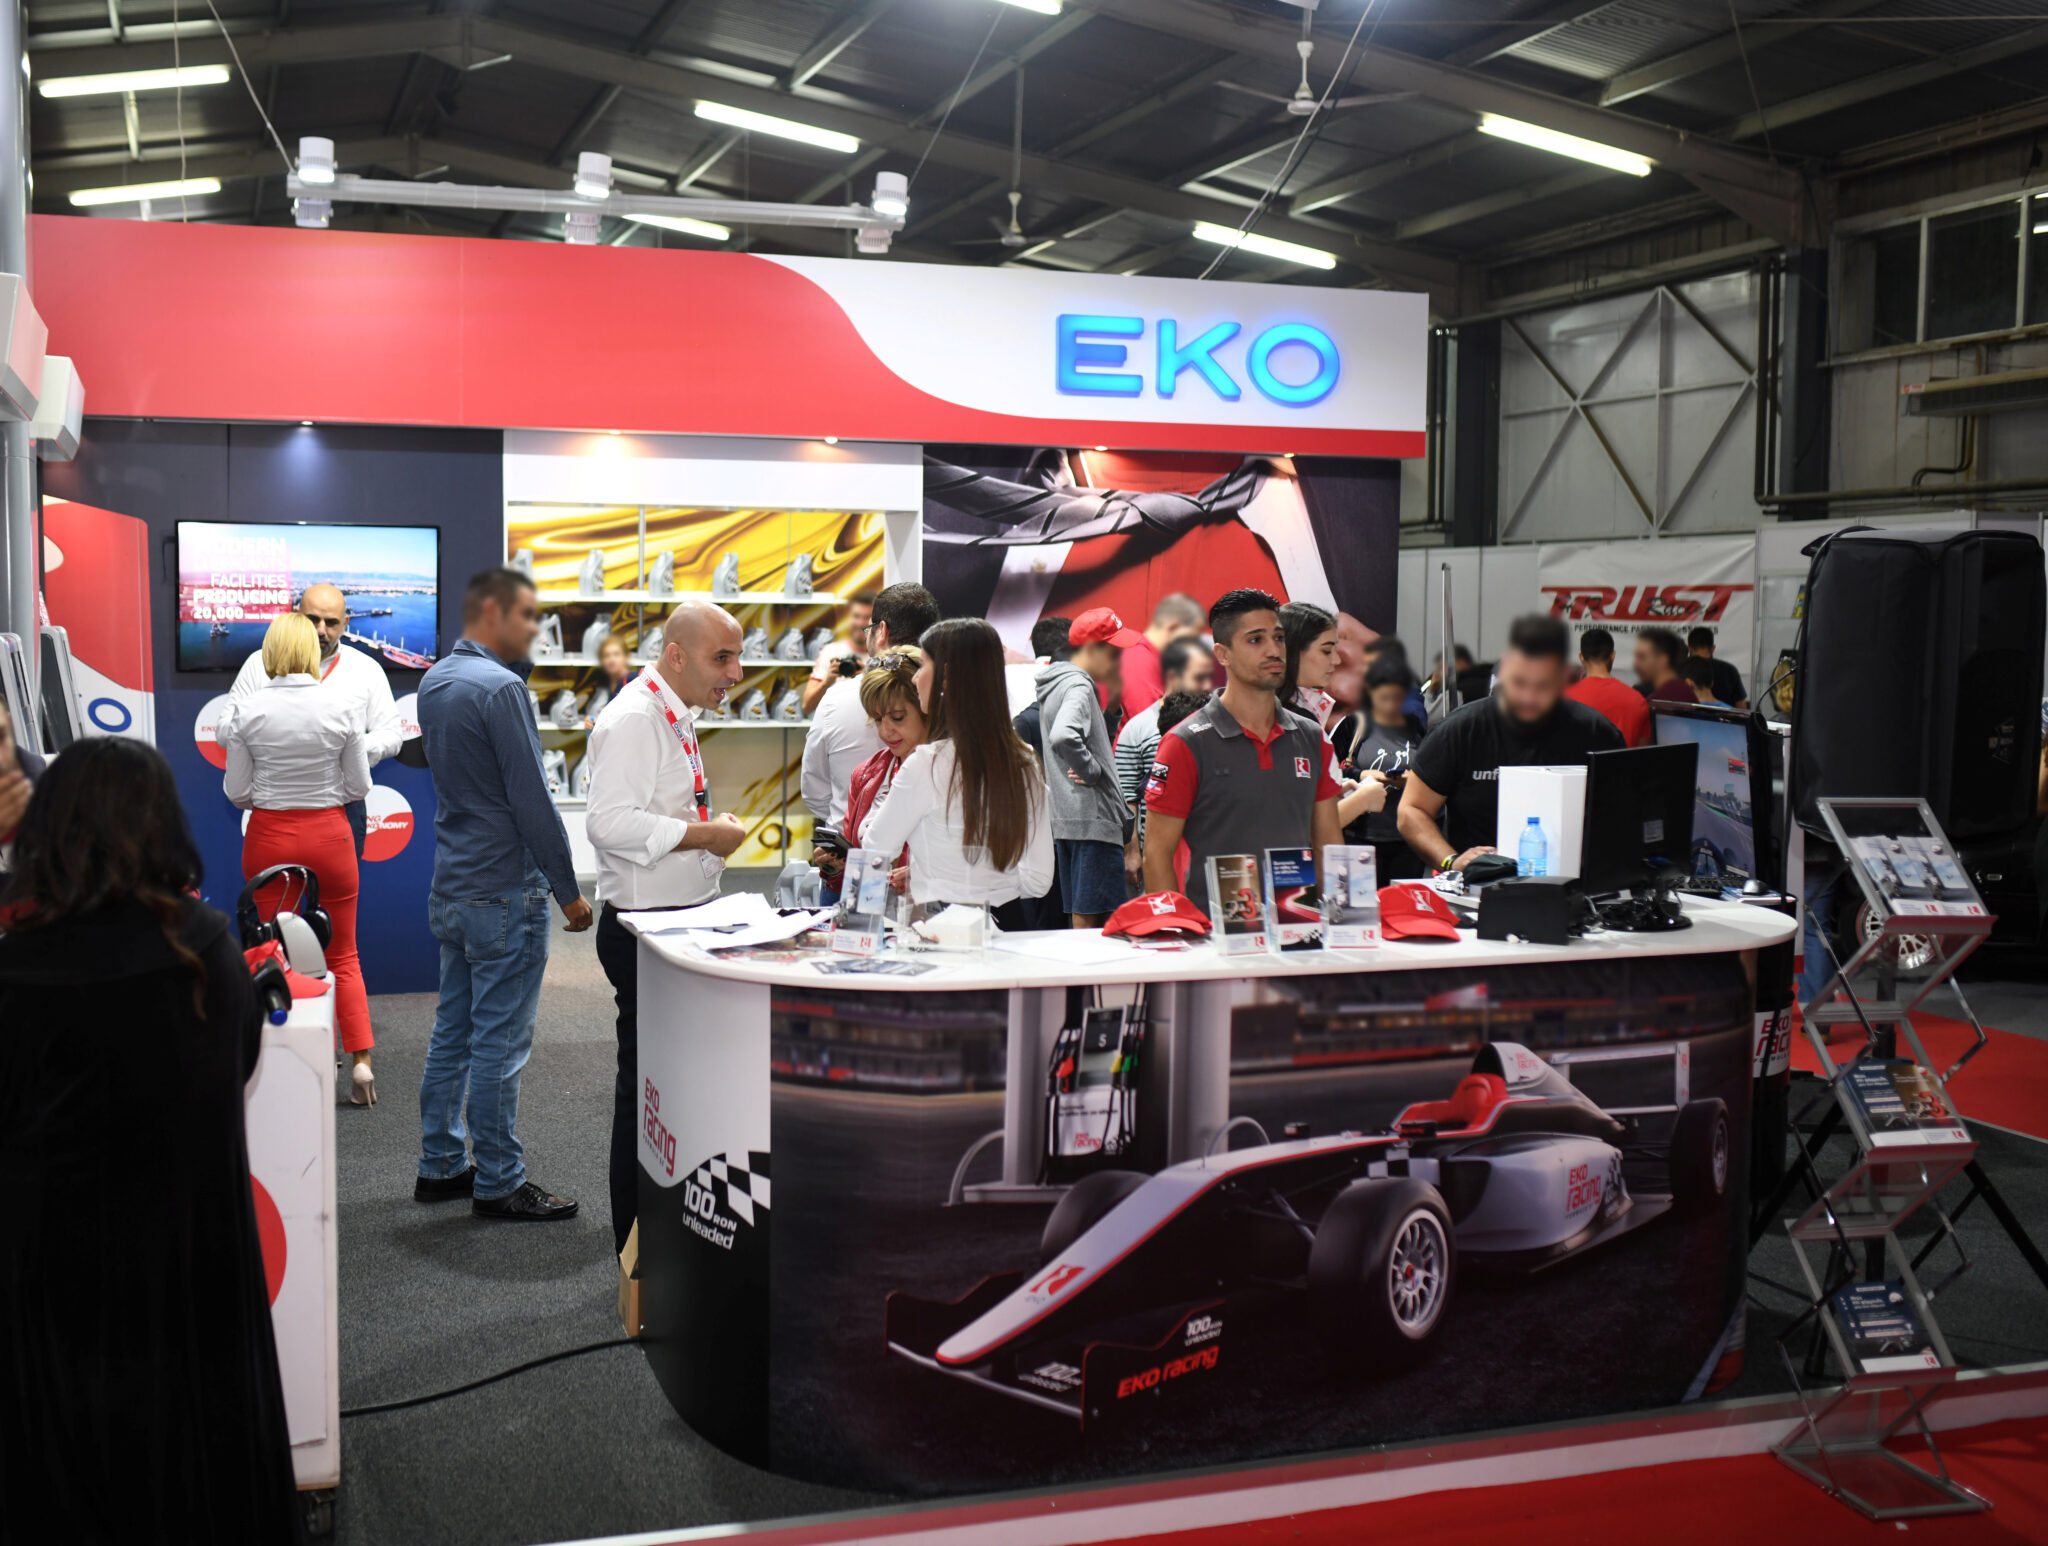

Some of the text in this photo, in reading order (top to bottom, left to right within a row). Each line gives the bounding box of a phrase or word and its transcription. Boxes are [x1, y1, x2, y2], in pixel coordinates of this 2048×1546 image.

[1056, 313, 1340, 408] EKO
[193, 589, 289, 604] PRODUCING
[210, 573, 288, 588] FACILITIES
[193, 606, 244, 621] 20,000
[1541, 584, 1754, 622] TRUST
[645, 1077, 660, 1113] EKO
[643, 1103, 677, 1177] racing
[1569, 1163, 1588, 1186] EKO
[683, 1178, 737, 1232] 100 RON
[1566, 1175, 1601, 1212] racing
[682, 1212, 735, 1250] unleaded
[1186, 1315, 1212, 1337] 100
[1117, 1367, 1161, 1400] EKO
[1162, 1345, 1219, 1382] racing
